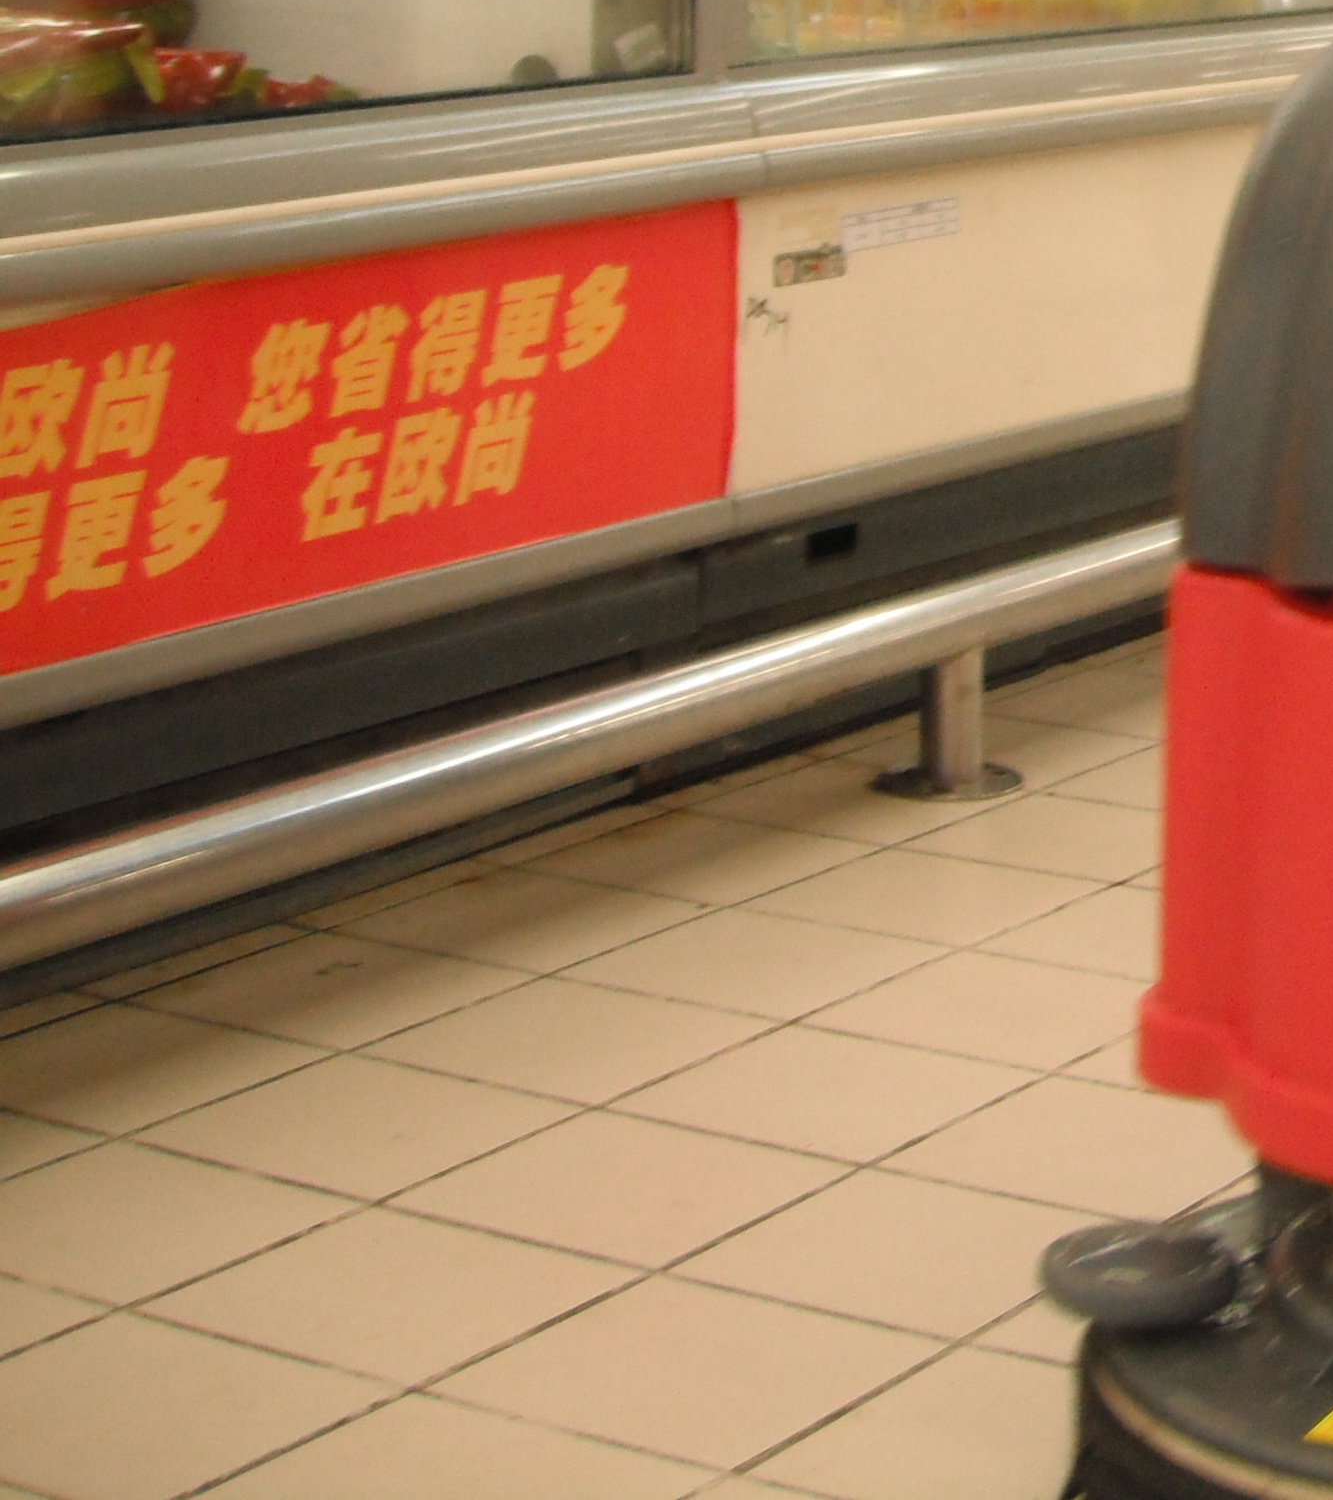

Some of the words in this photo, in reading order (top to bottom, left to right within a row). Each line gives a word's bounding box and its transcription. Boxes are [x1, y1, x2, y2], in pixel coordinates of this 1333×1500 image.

[236, 264, 629, 434] 您省得更多
[301, 391, 534, 542] 在欧尚
